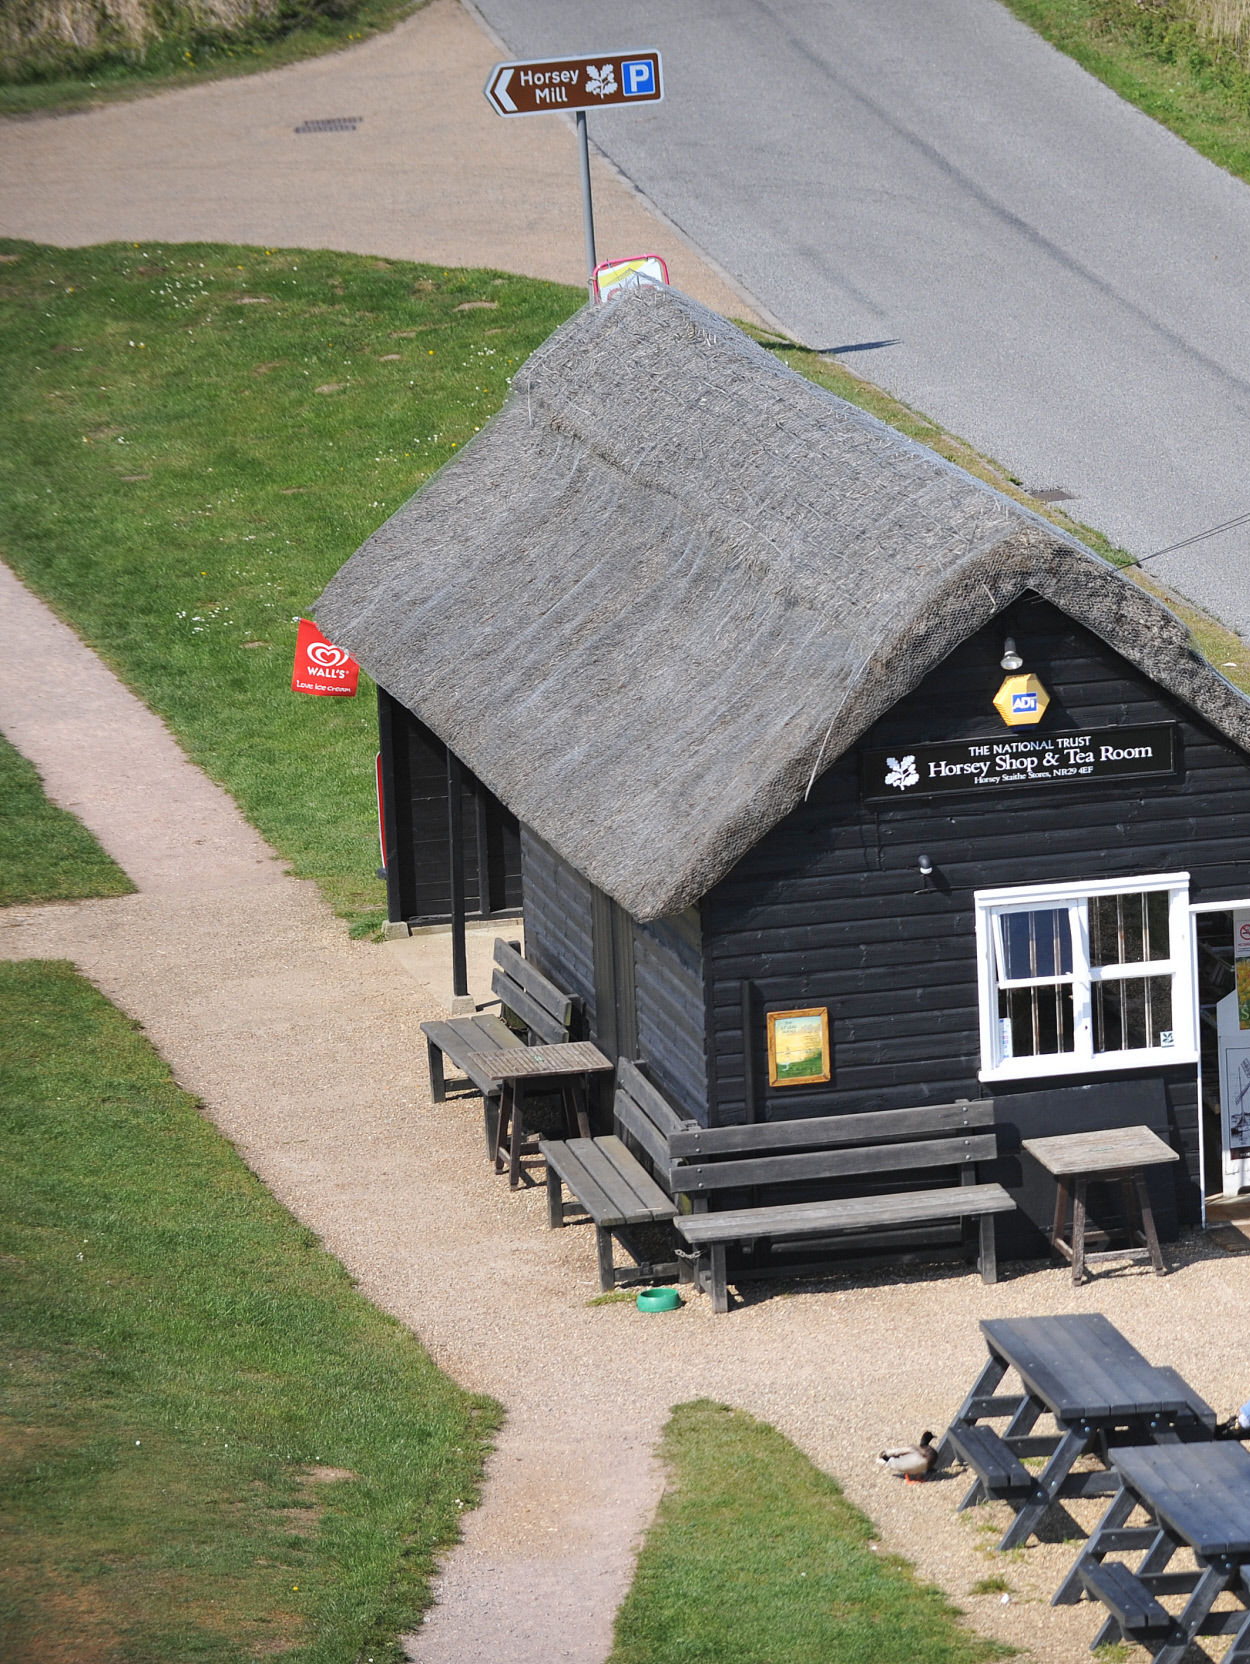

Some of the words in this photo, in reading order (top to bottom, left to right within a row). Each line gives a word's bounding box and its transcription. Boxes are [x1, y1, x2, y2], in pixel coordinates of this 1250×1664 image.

[519, 69, 579, 88] Horsey
[629, 64, 650, 93] P
[534, 86, 569, 105] Mill
[307, 666, 345, 679] WALL'S
[968, 745, 991, 757] THE
[993, 739, 1055, 755] NATIONAL
[1056, 736, 1092, 749] TRUST
[928, 760, 991, 778] Horsey
[995, 754, 1038, 772] Shop
[1042, 751, 1060, 767] &
[1064, 748, 1095, 764] Tea
[1099, 745, 1153, 761] Room
[974, 776, 1000, 784] Horsey
[1053, 767, 1077, 777] NR29
[1078, 765, 1094, 774] 4EF
